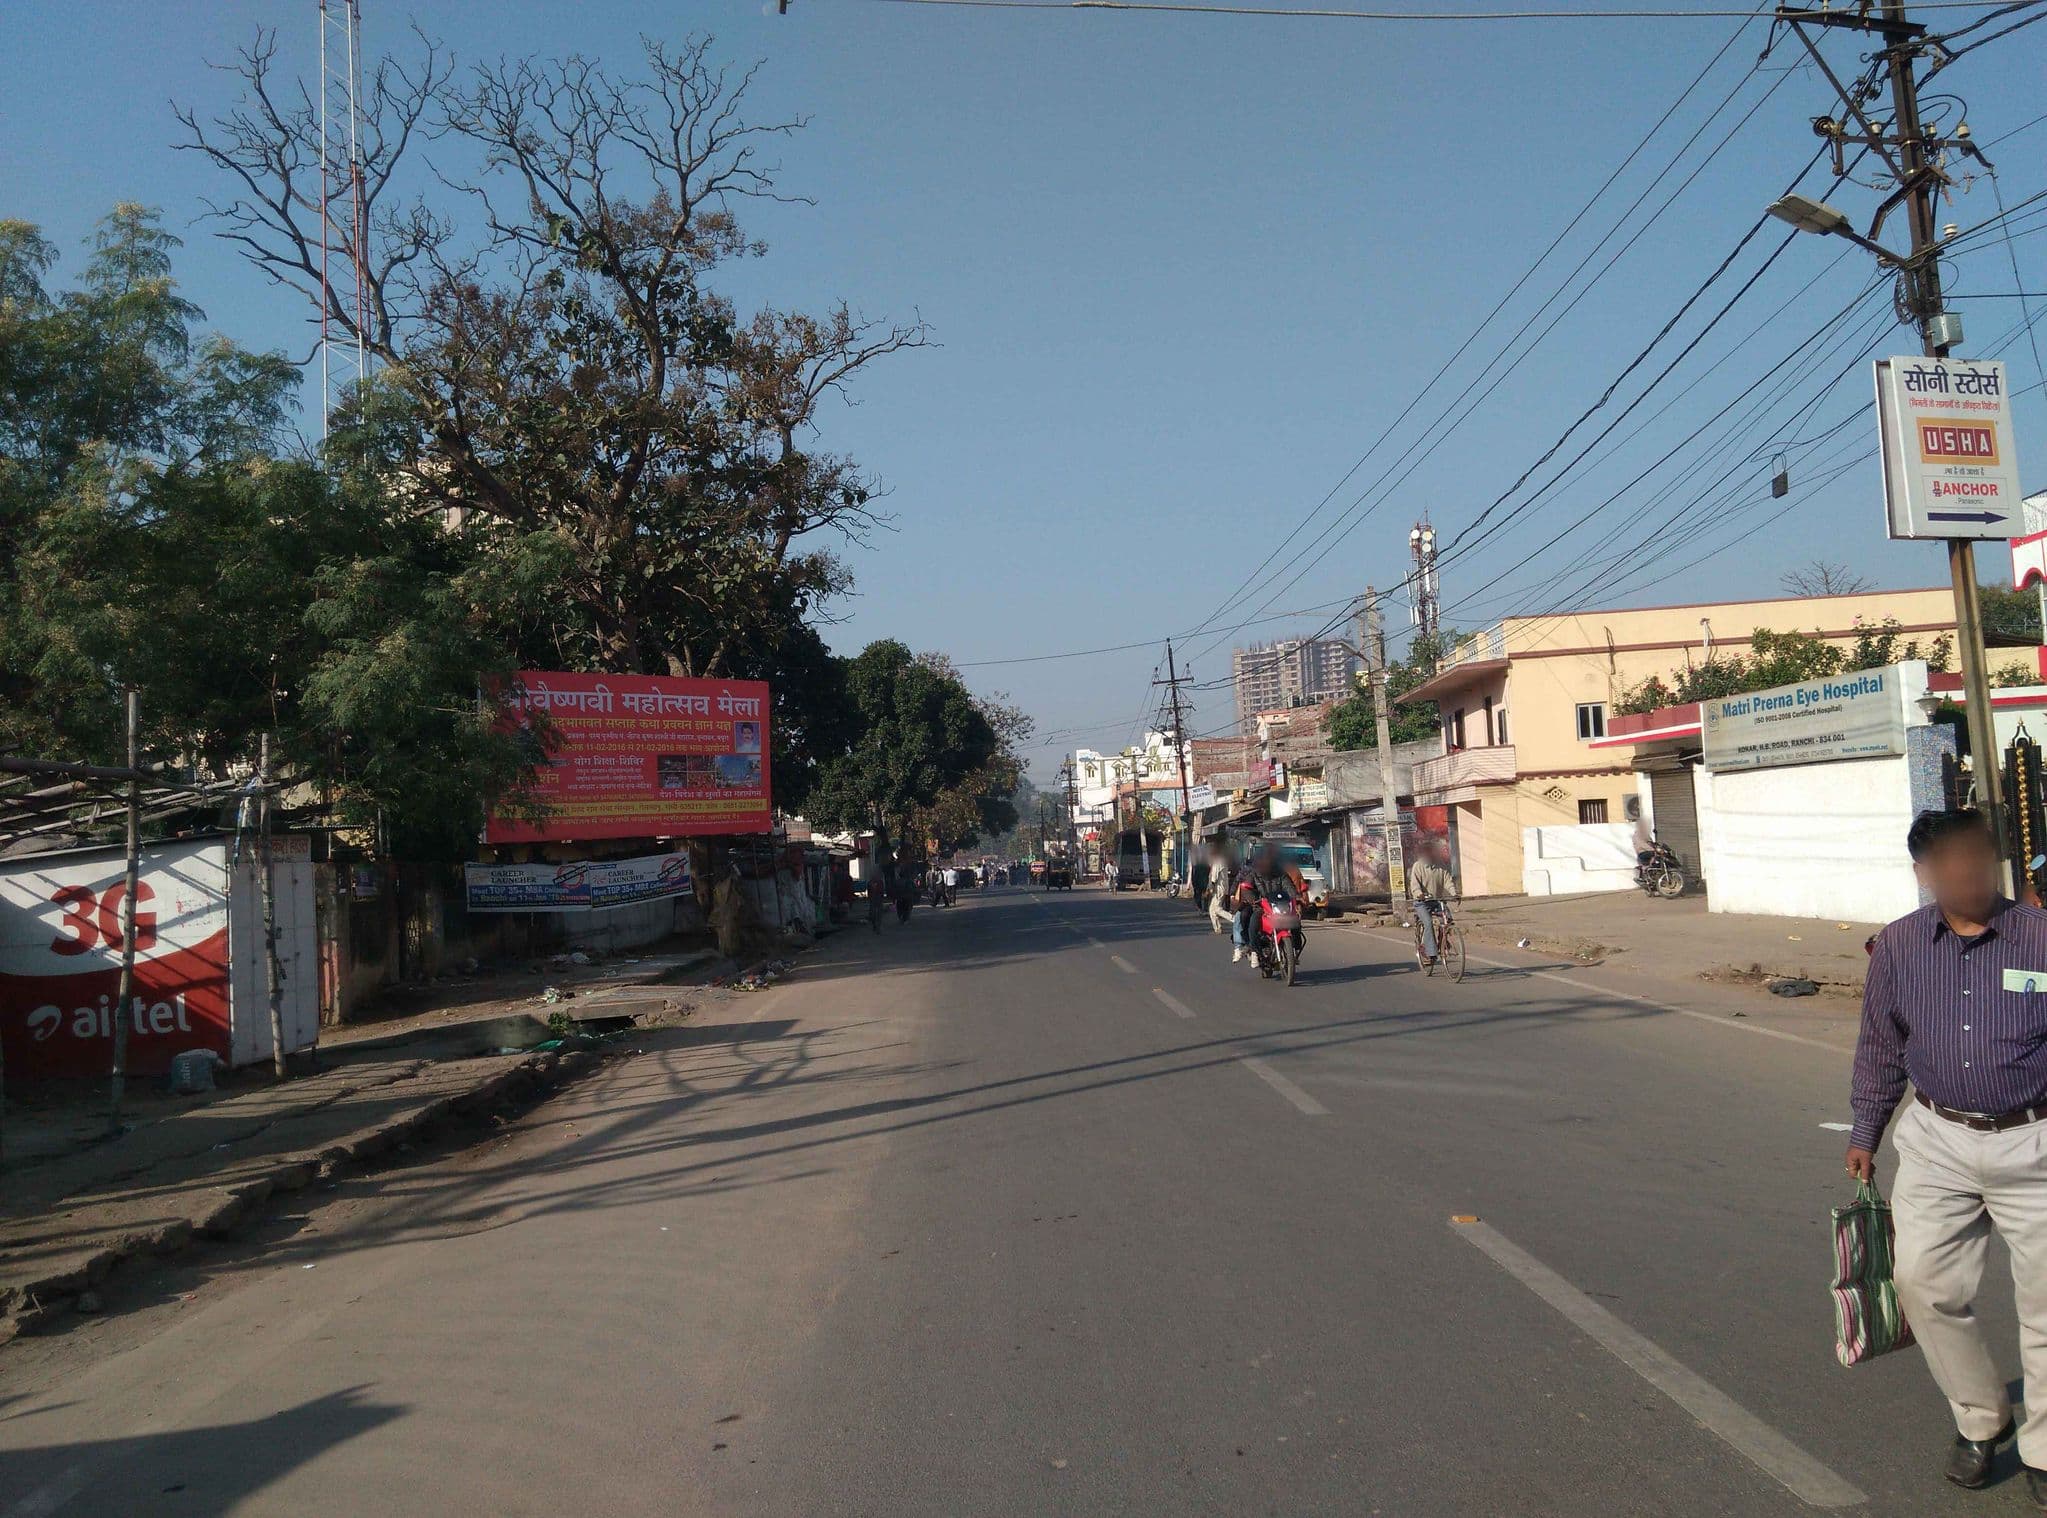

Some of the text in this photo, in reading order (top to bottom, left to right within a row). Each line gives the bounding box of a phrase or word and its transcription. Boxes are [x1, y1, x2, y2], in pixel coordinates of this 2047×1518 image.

[1903, 364, 2000, 395] सोनी स्टोर्स
[1926, 431, 1990, 452] USHA
[1943, 483, 1999, 496] ANCHOR
[621, 686, 710, 715] महोत्सव
[717, 689, 760, 717] मेला
[1722, 674, 1883, 718] Matri Prerna Eye Hospital
[608, 869, 634, 877] CAREER
[608, 874, 645, 884] LAUNCHER
[50, 879, 157, 956] 3G
[72, 992, 192, 1038] aitel
